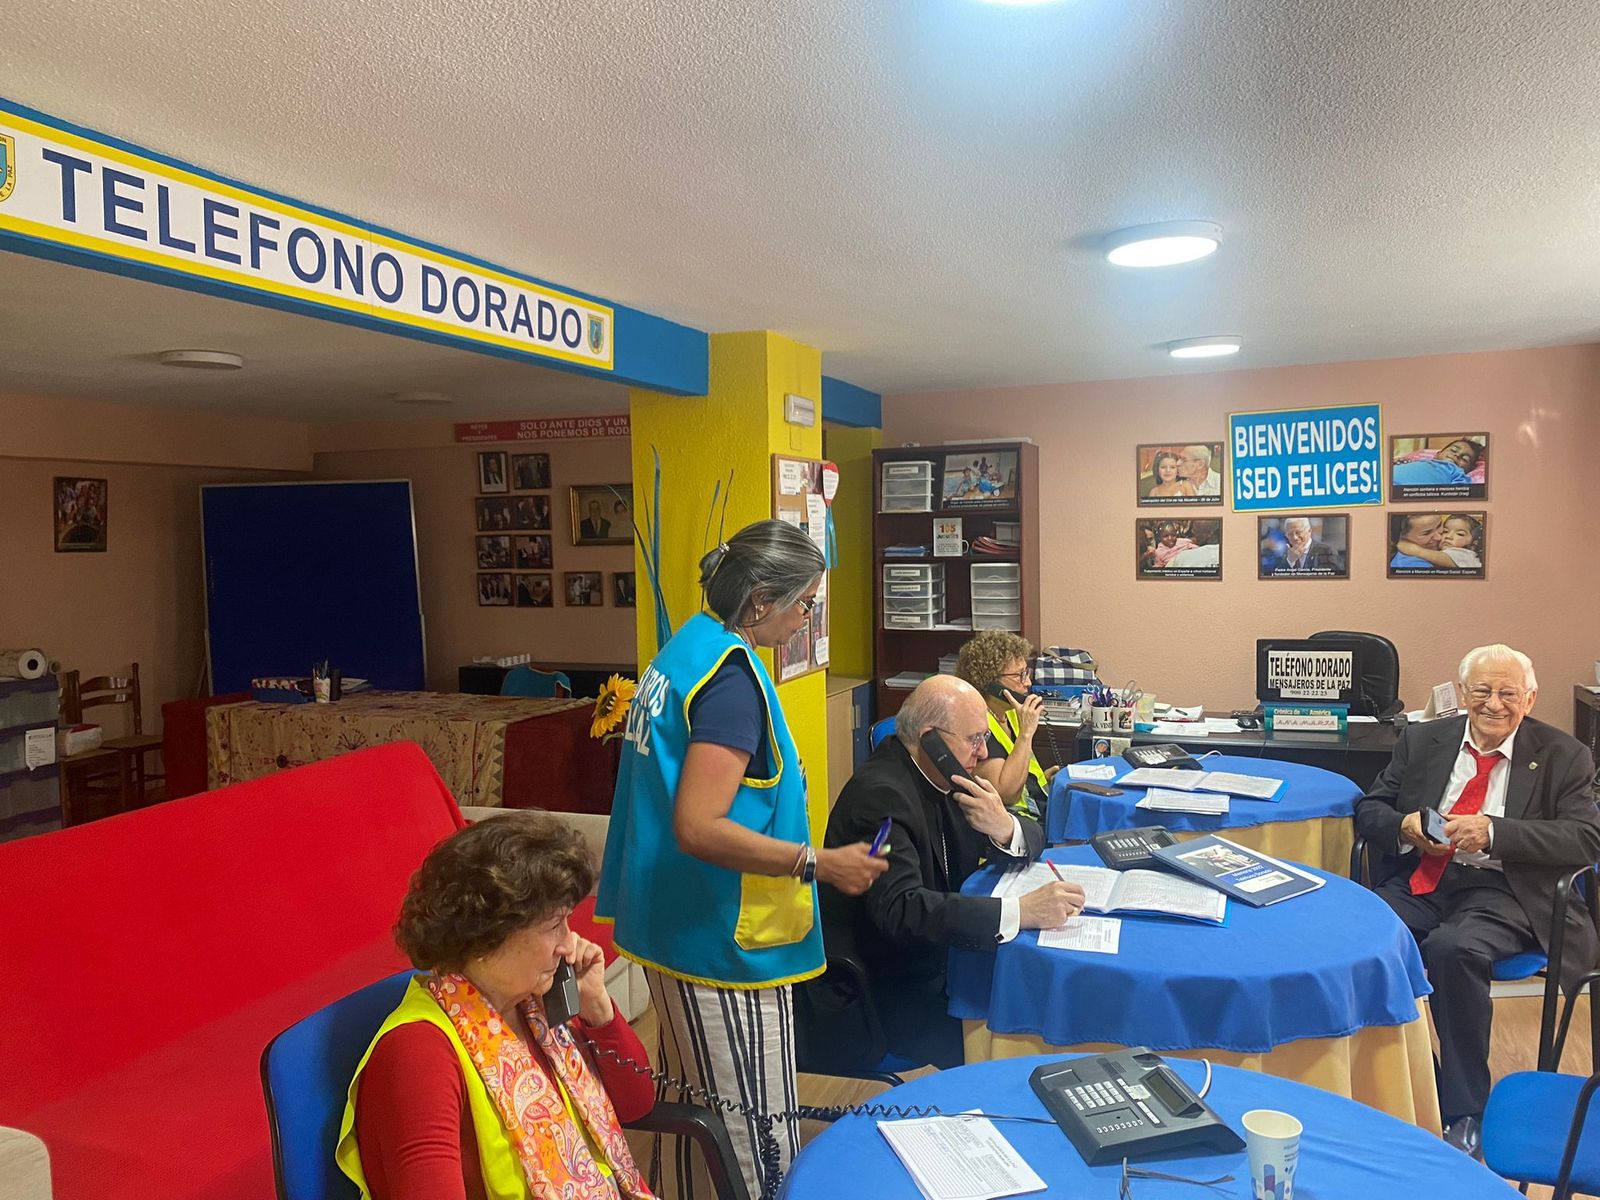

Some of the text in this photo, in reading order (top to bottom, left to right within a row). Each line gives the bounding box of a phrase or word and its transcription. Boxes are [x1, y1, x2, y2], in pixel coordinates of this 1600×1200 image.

[42, 148, 582, 349] TELEFONO DORADO
[517, 430, 537, 439] NOS
[540, 428, 590, 438] PONEMOS
[592, 427, 605, 436] DE
[520, 417, 627, 431] SOLO ANTE DIOS Y UN
[1235, 417, 1376, 458] BIENVENIDOS
[1237, 460, 1378, 500] ¡SED FELICES!
[1270, 653, 1351, 678] TELÉFONO DORADO
[1270, 679, 1351, 690] MENSAJEROS DE LA PAZ
